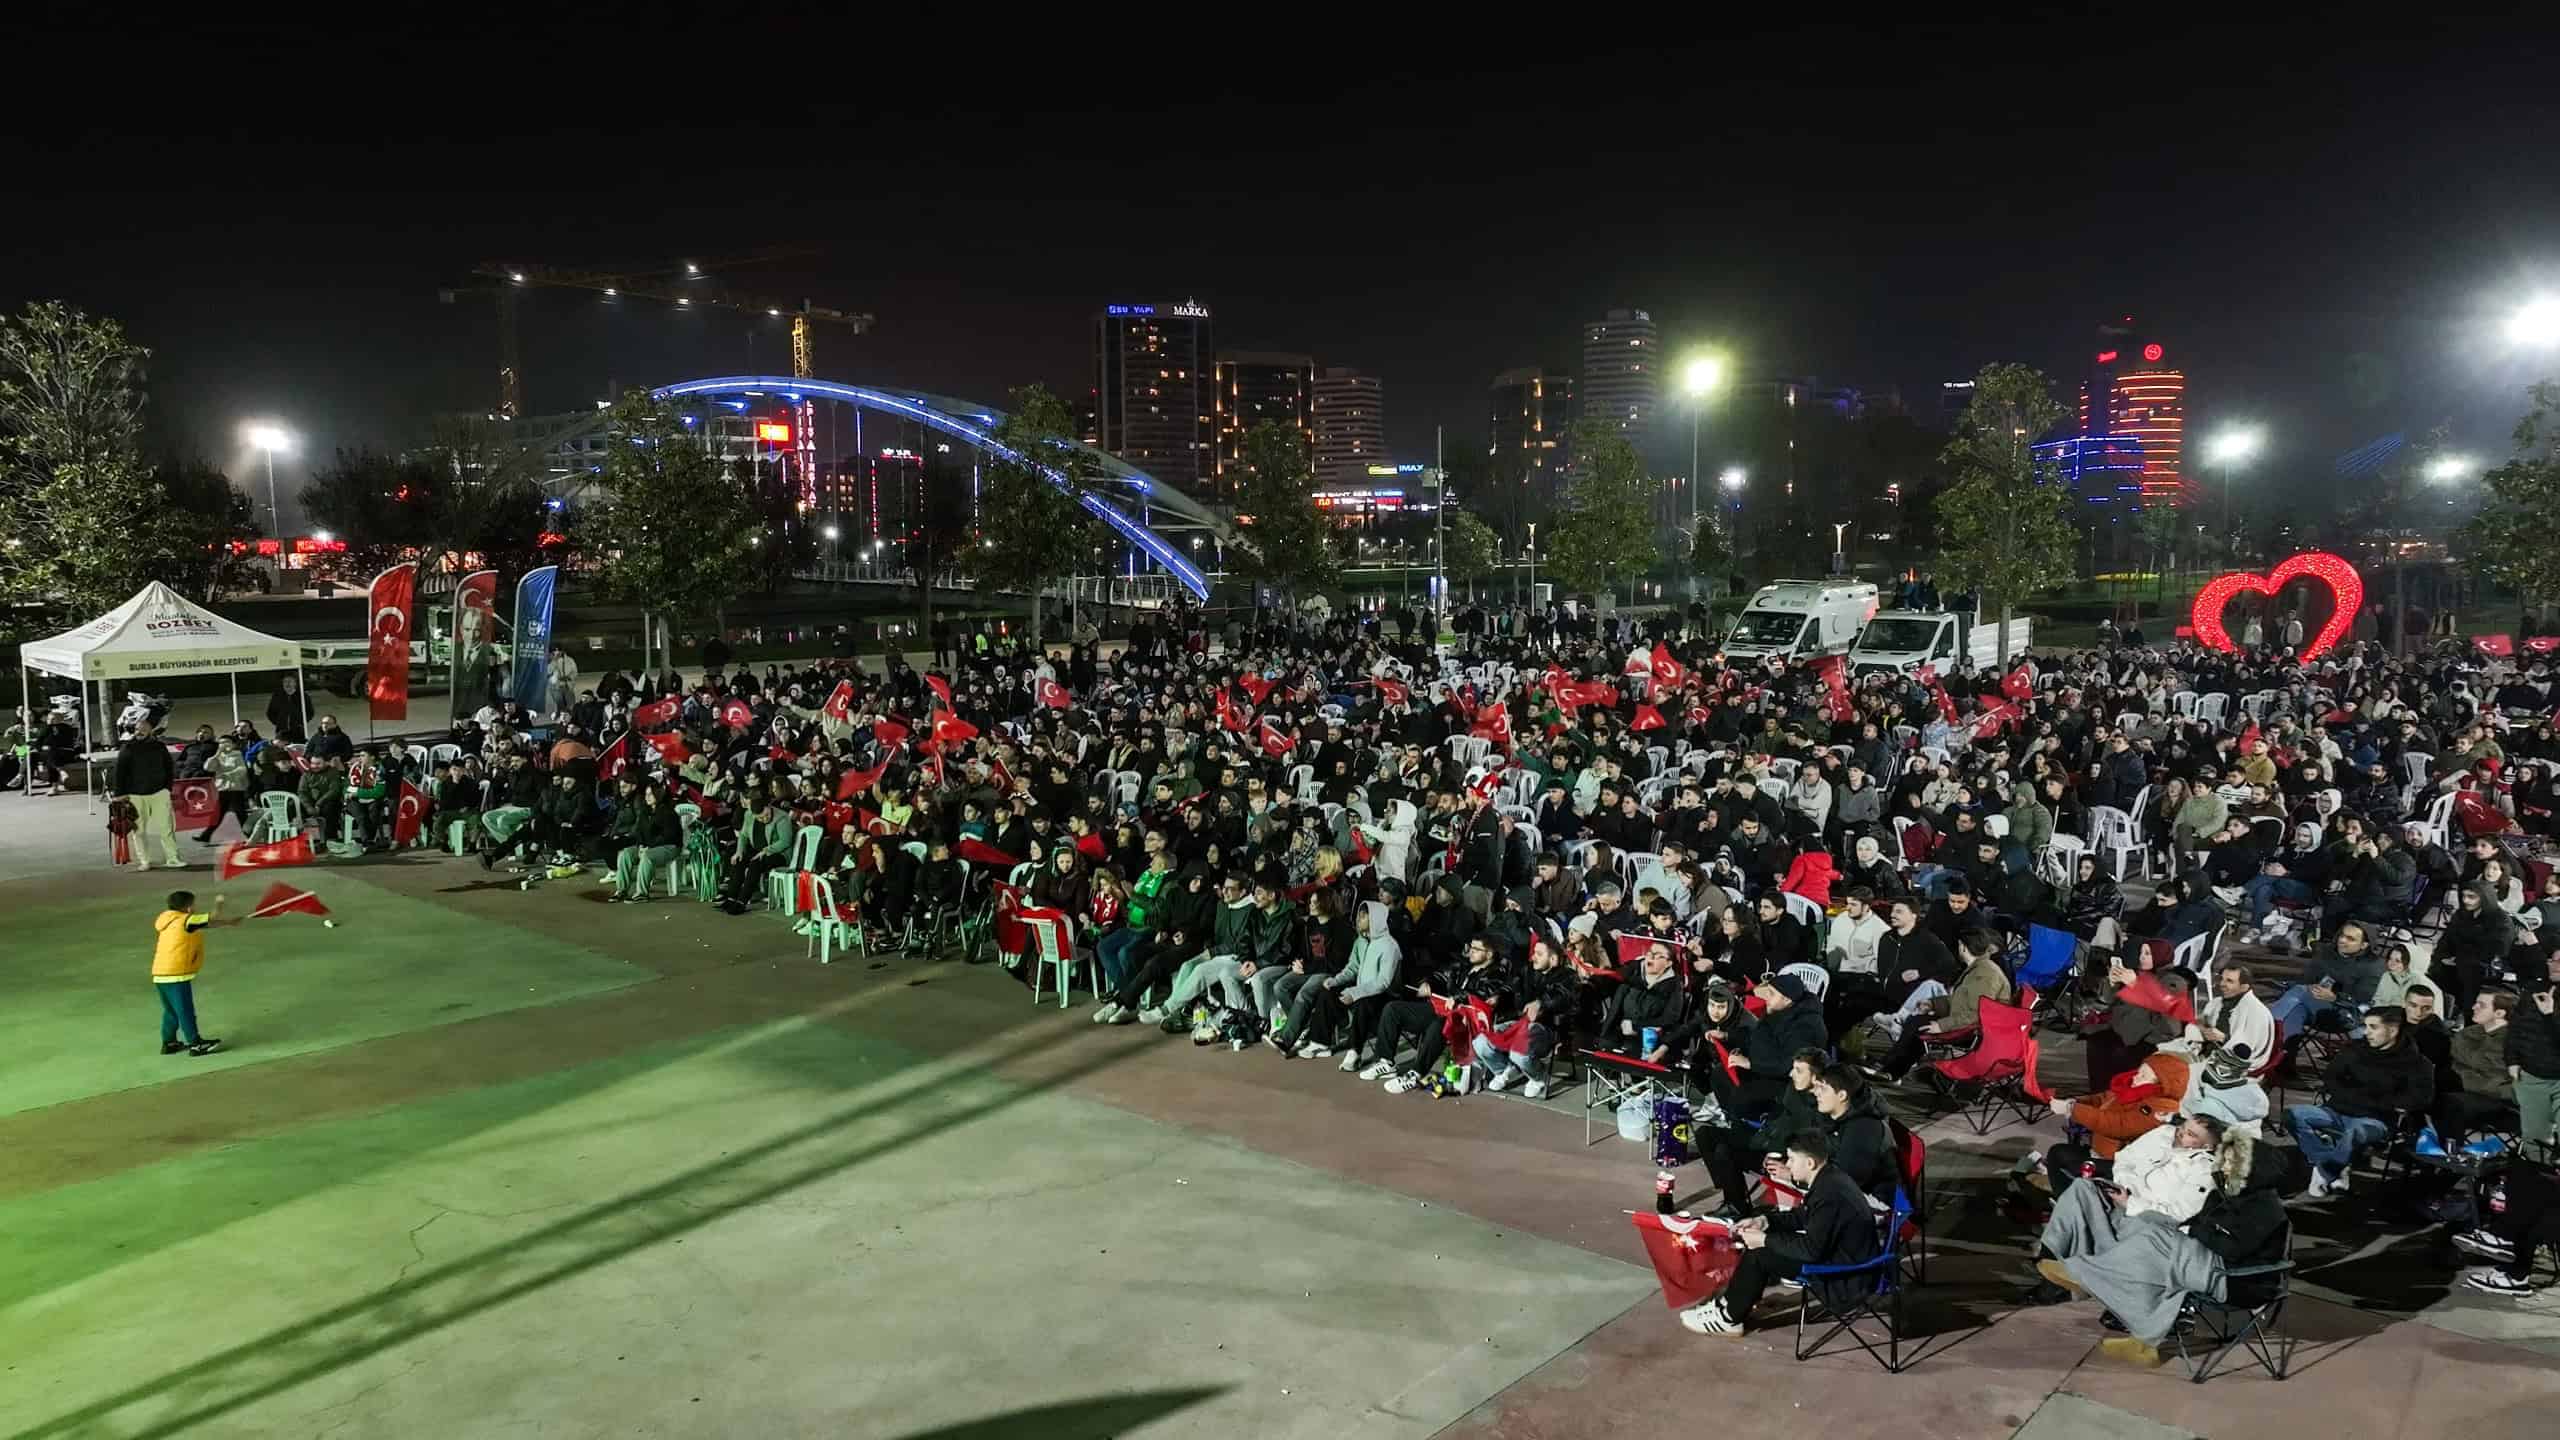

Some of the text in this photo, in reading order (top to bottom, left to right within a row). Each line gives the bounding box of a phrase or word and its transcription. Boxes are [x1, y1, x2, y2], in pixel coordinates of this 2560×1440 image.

[1174, 306, 1208, 317] MARKA
[1399, 464, 1425, 472] IMAX
[146, 620, 212, 630] BOZBEY
[129, 656, 258, 671] BURSA BÜYÜKŞEHİR BELEDİYESİ
